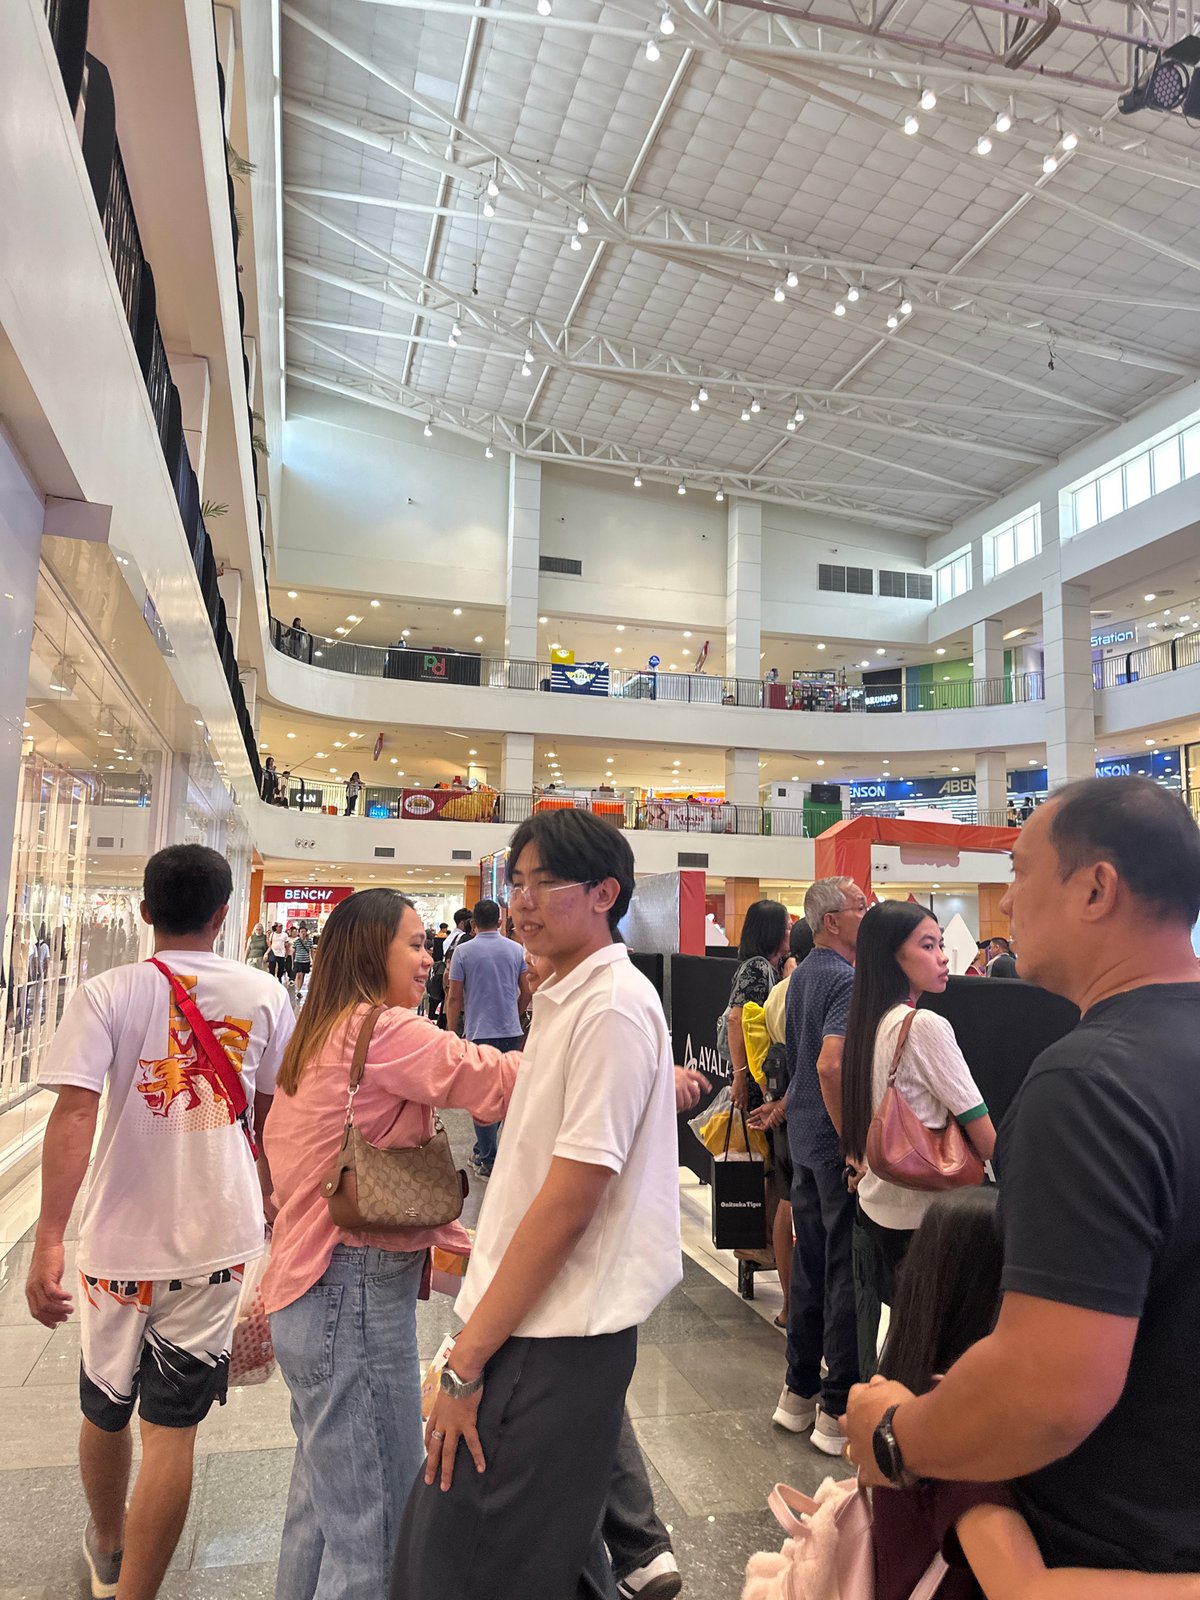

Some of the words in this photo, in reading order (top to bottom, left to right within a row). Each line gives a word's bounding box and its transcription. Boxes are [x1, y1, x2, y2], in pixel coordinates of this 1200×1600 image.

[1090, 631, 1134, 647] Station
[865, 694, 898, 705] BRUNO'S
[1095, 763, 1130, 778] NSON
[849, 785, 886, 798] ENSON
[938, 775, 1012, 794] ABENN
[295, 793, 317, 803] CLN
